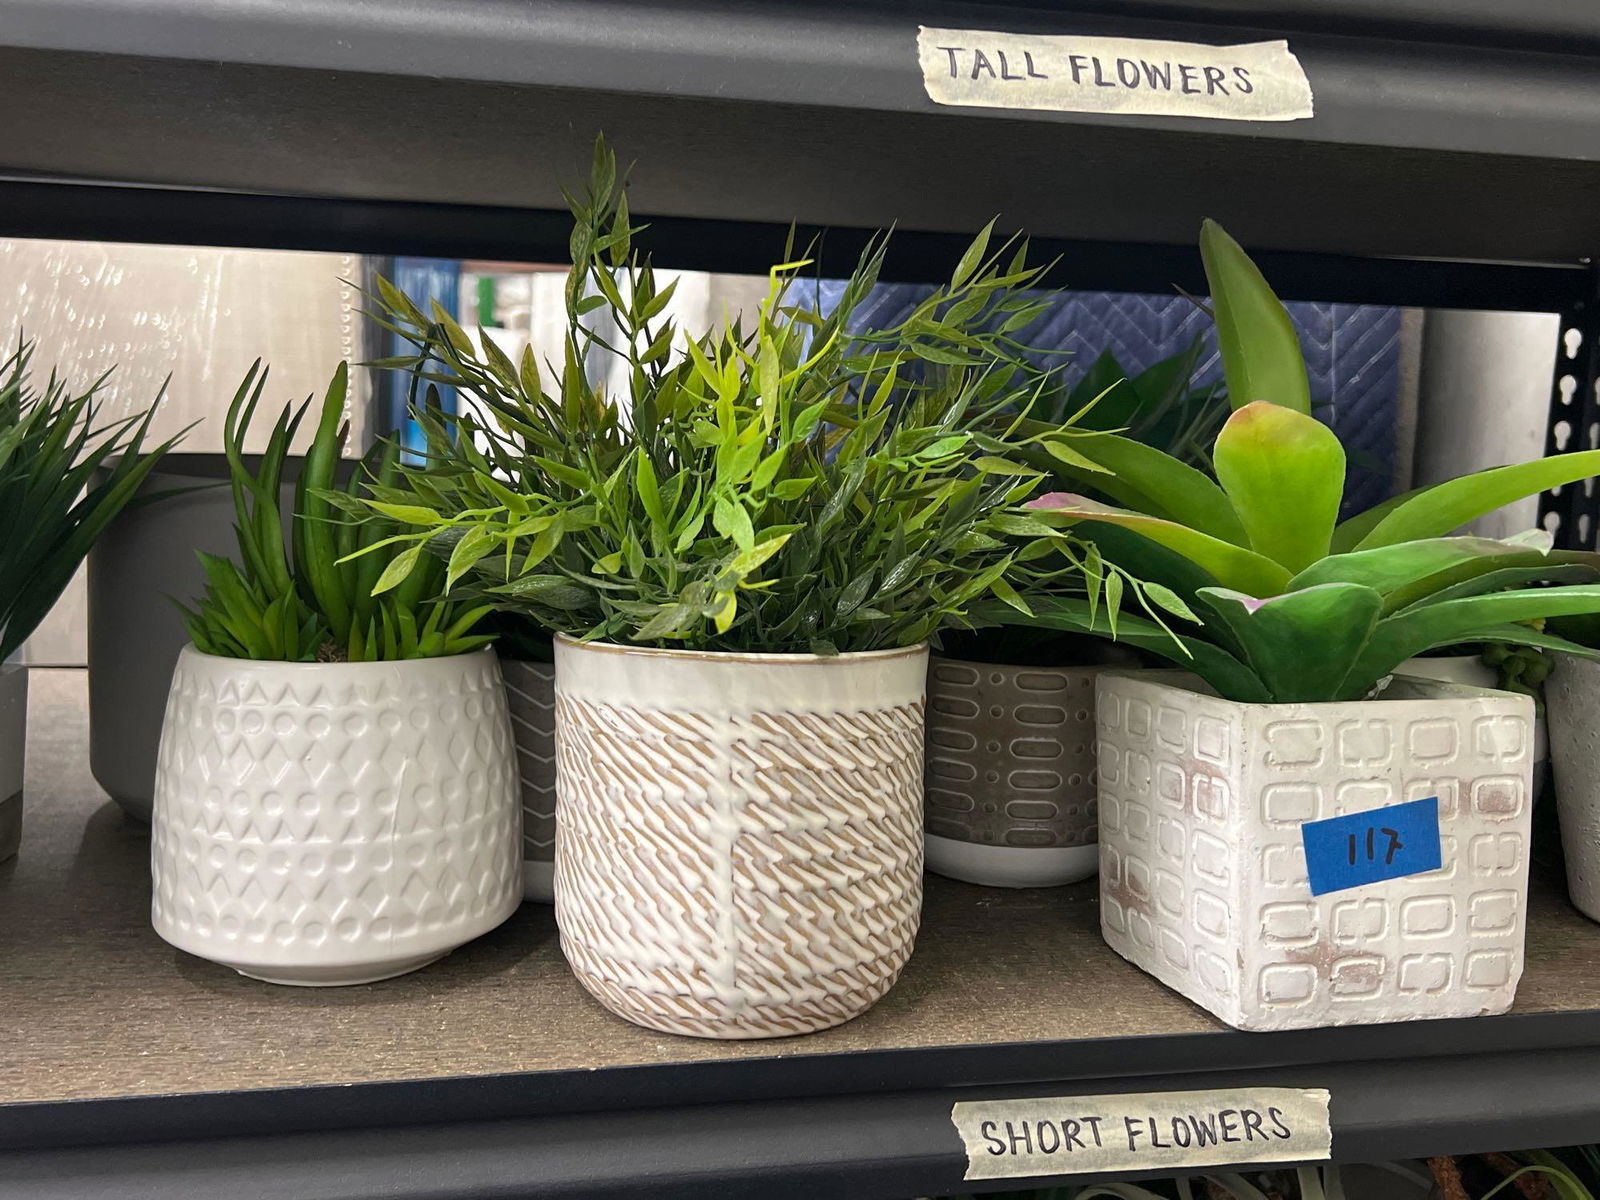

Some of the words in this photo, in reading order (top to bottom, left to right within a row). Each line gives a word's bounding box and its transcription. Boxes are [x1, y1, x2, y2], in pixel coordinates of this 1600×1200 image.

[936, 46, 1049, 81] TALL
[1068, 54, 1255, 96] FLOWERS
[1348, 827, 1404, 865] 117
[980, 1115, 1103, 1156] SHORT
[1123, 1106, 1292, 1152] FLOWERS
